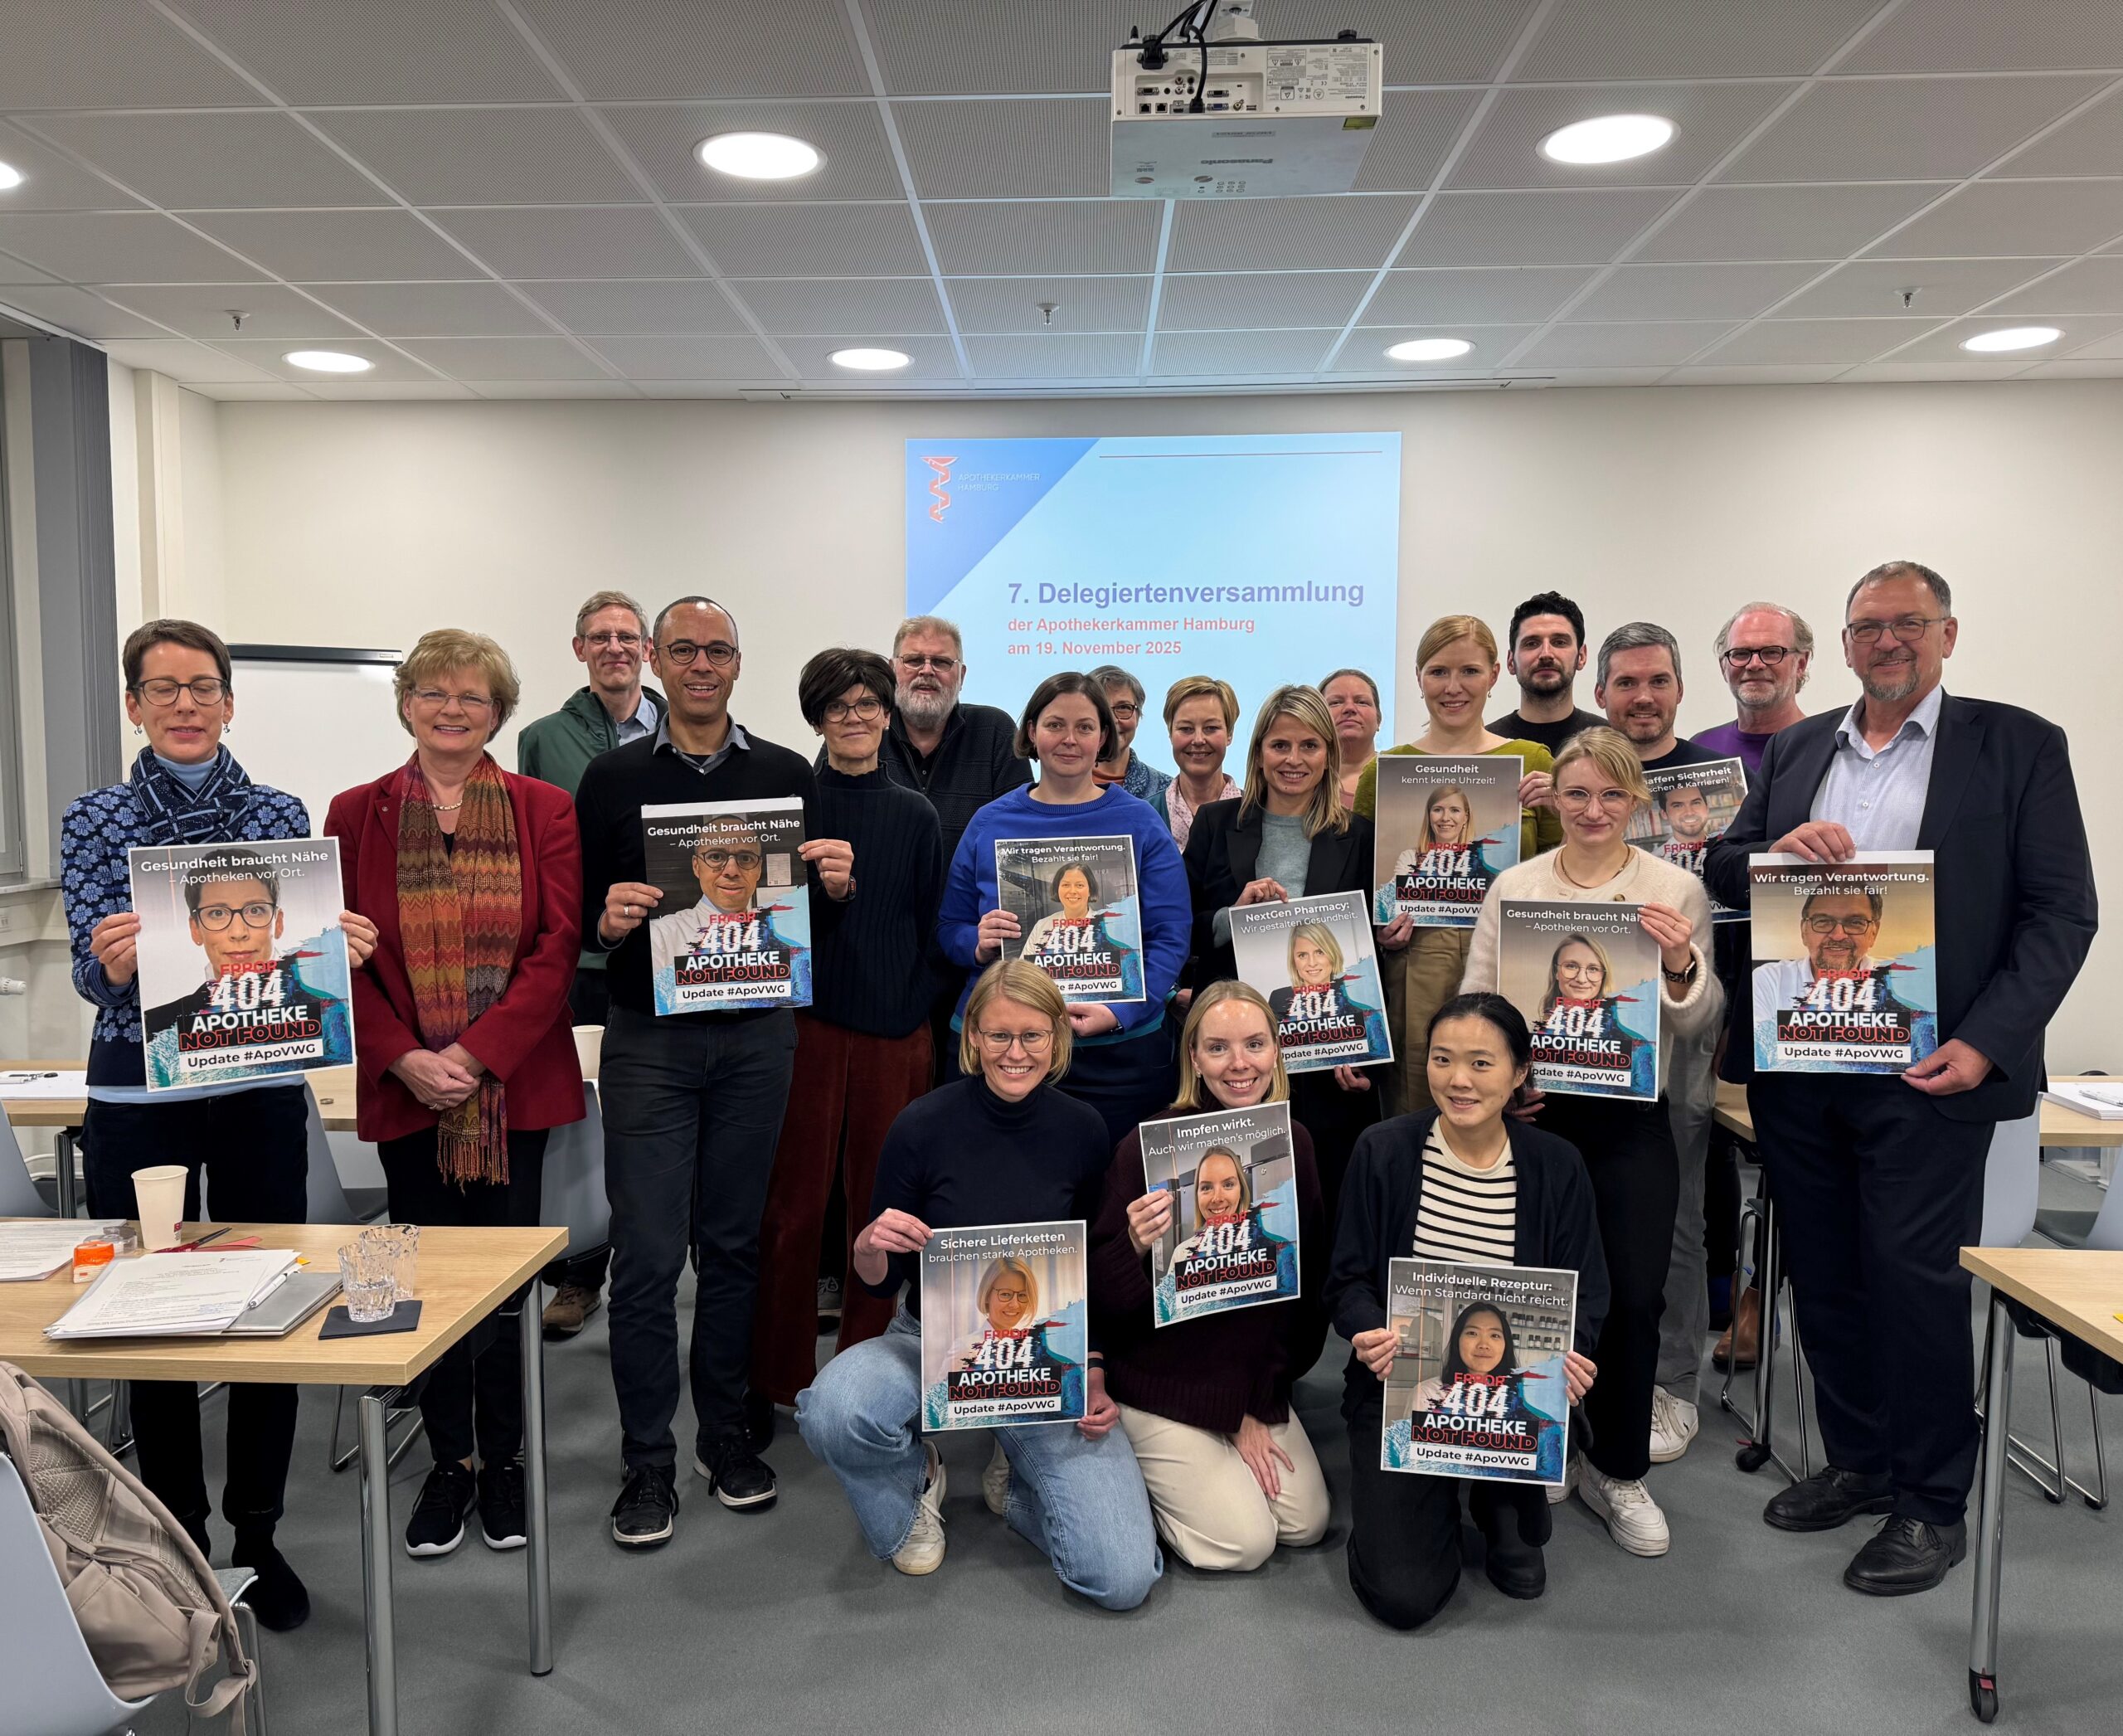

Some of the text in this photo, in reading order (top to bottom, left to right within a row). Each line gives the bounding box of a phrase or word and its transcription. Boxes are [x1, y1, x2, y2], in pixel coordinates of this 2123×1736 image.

[959, 473, 1041, 481] APOTHEKERKAMMER
[1008, 580, 1364, 609] 7. Delegiertenversammlung
[1008, 616, 1255, 635] der Apothekerkammer Hamburg
[1008, 640, 1181, 654] am 19. November 2025
[1416, 765, 1479, 774] Gesundheit
[1677, 767, 1731, 780] Sicherheit
[1686, 777, 1729, 788] Karrieren!
[648, 819, 800, 836] Gesundheit braucht Nähe
[678, 836, 738, 849] Apotheken
[1022, 847, 1052, 855] tragen
[1054, 845, 1125, 853] Verantwortung.
[141, 851, 328, 871] Gesundheit braucht Nähe
[1032, 855, 1065, 863] Bezahlt
[1421, 850, 1472, 877] 404
[179, 872, 253, 885] Apotheken
[257, 870, 276, 879] vor
[280, 868, 305, 878] Ort.
[1405, 877, 1486, 889] APOTHEKE
[1755, 873, 1929, 883] Wir tragen Verantwortung.
[1397, 887, 1484, 902] NOT FOUN
[1794, 886, 1839, 895] Bezahlt
[1864, 886, 1887, 894] fair!
[1246, 902, 1350, 922] NextGen Pharmacy:
[1439, 906, 1482, 914] #ApoVW
[1507, 909, 1570, 920] Gesundheit
[1574, 912, 1617, 921] braucht
[1241, 912, 1358, 934] Wir gestalten Gesundheit.
[1533, 922, 1589, 932] Apotheken
[1611, 925, 1630, 934] Ort.
[702, 920, 762, 953] 404
[1047, 926, 1096, 954] 404
[685, 951, 780, 970] APOTHEKE
[1034, 952, 1111, 967] APOTHEKE
[676, 964, 790, 985] NOT FOUND
[1065, 964, 1121, 977] FOUND
[209, 970, 286, 1010] 404
[683, 985, 785, 999] Update #ApoVWG
[1068, 982, 1117, 991] #ApoVWG
[1808, 978, 1878, 1011] 404
[1290, 990, 1338, 1020] 404
[192, 1005, 307, 1033] APOTHEKE
[1278, 1015, 1355, 1035] APOTHEKE
[1547, 1005, 1605, 1038] 404
[1789, 1012, 1897, 1027] APOTHEKE
[180, 1020, 322, 1050] NOT FOUND
[1309, 1025, 1366, 1042] FOUND
[1778, 1025, 1910, 1043] NOT FOUND
[1314, 1043, 1363, 1055] #ApoVWG
[1530, 1035, 1620, 1053] APOTHEKE
[1785, 1048, 1903, 1058] Update #ApoVWG
[187, 1044, 315, 1068] Update #ApoVWG
[1533, 1048, 1630, 1067] OT FOUND
[1533, 1067, 1625, 1082] pdate #ApoVWG
[1177, 1117, 1255, 1139] Impfen wirkt.
[1149, 1126, 1285, 1156] Auch wir machen's möglich.
[940, 1233, 1065, 1249] Sichere Lieferketten
[1198, 1219, 1252, 1257] 404
[929, 1245, 1077, 1262] brauchen starke Apotheken.
[1184, 1248, 1267, 1275] APOTHEKE
[1176, 1260, 1276, 1290] NOT FOUND
[1412, 1272, 1552, 1291] Individuelle Rezeptur:
[1182, 1280, 1271, 1304] Update #ApoVWG
[1396, 1285, 1568, 1306] Wenn Standard nicht reicht.
[975, 1336, 1033, 1369] 404
[959, 1368, 1051, 1386] APOTHEKE
[949, 1380, 1061, 1399] NOT FOUND
[955, 1401, 1055, 1414] Update #ApoVWG
[1442, 1382, 1509, 1418] 404
[1423, 1414, 1527, 1436] APOTHEKE
[1412, 1425, 1537, 1450] NOT FOUND
[1416, 1447, 1529, 1466] Update #ApoVWG
